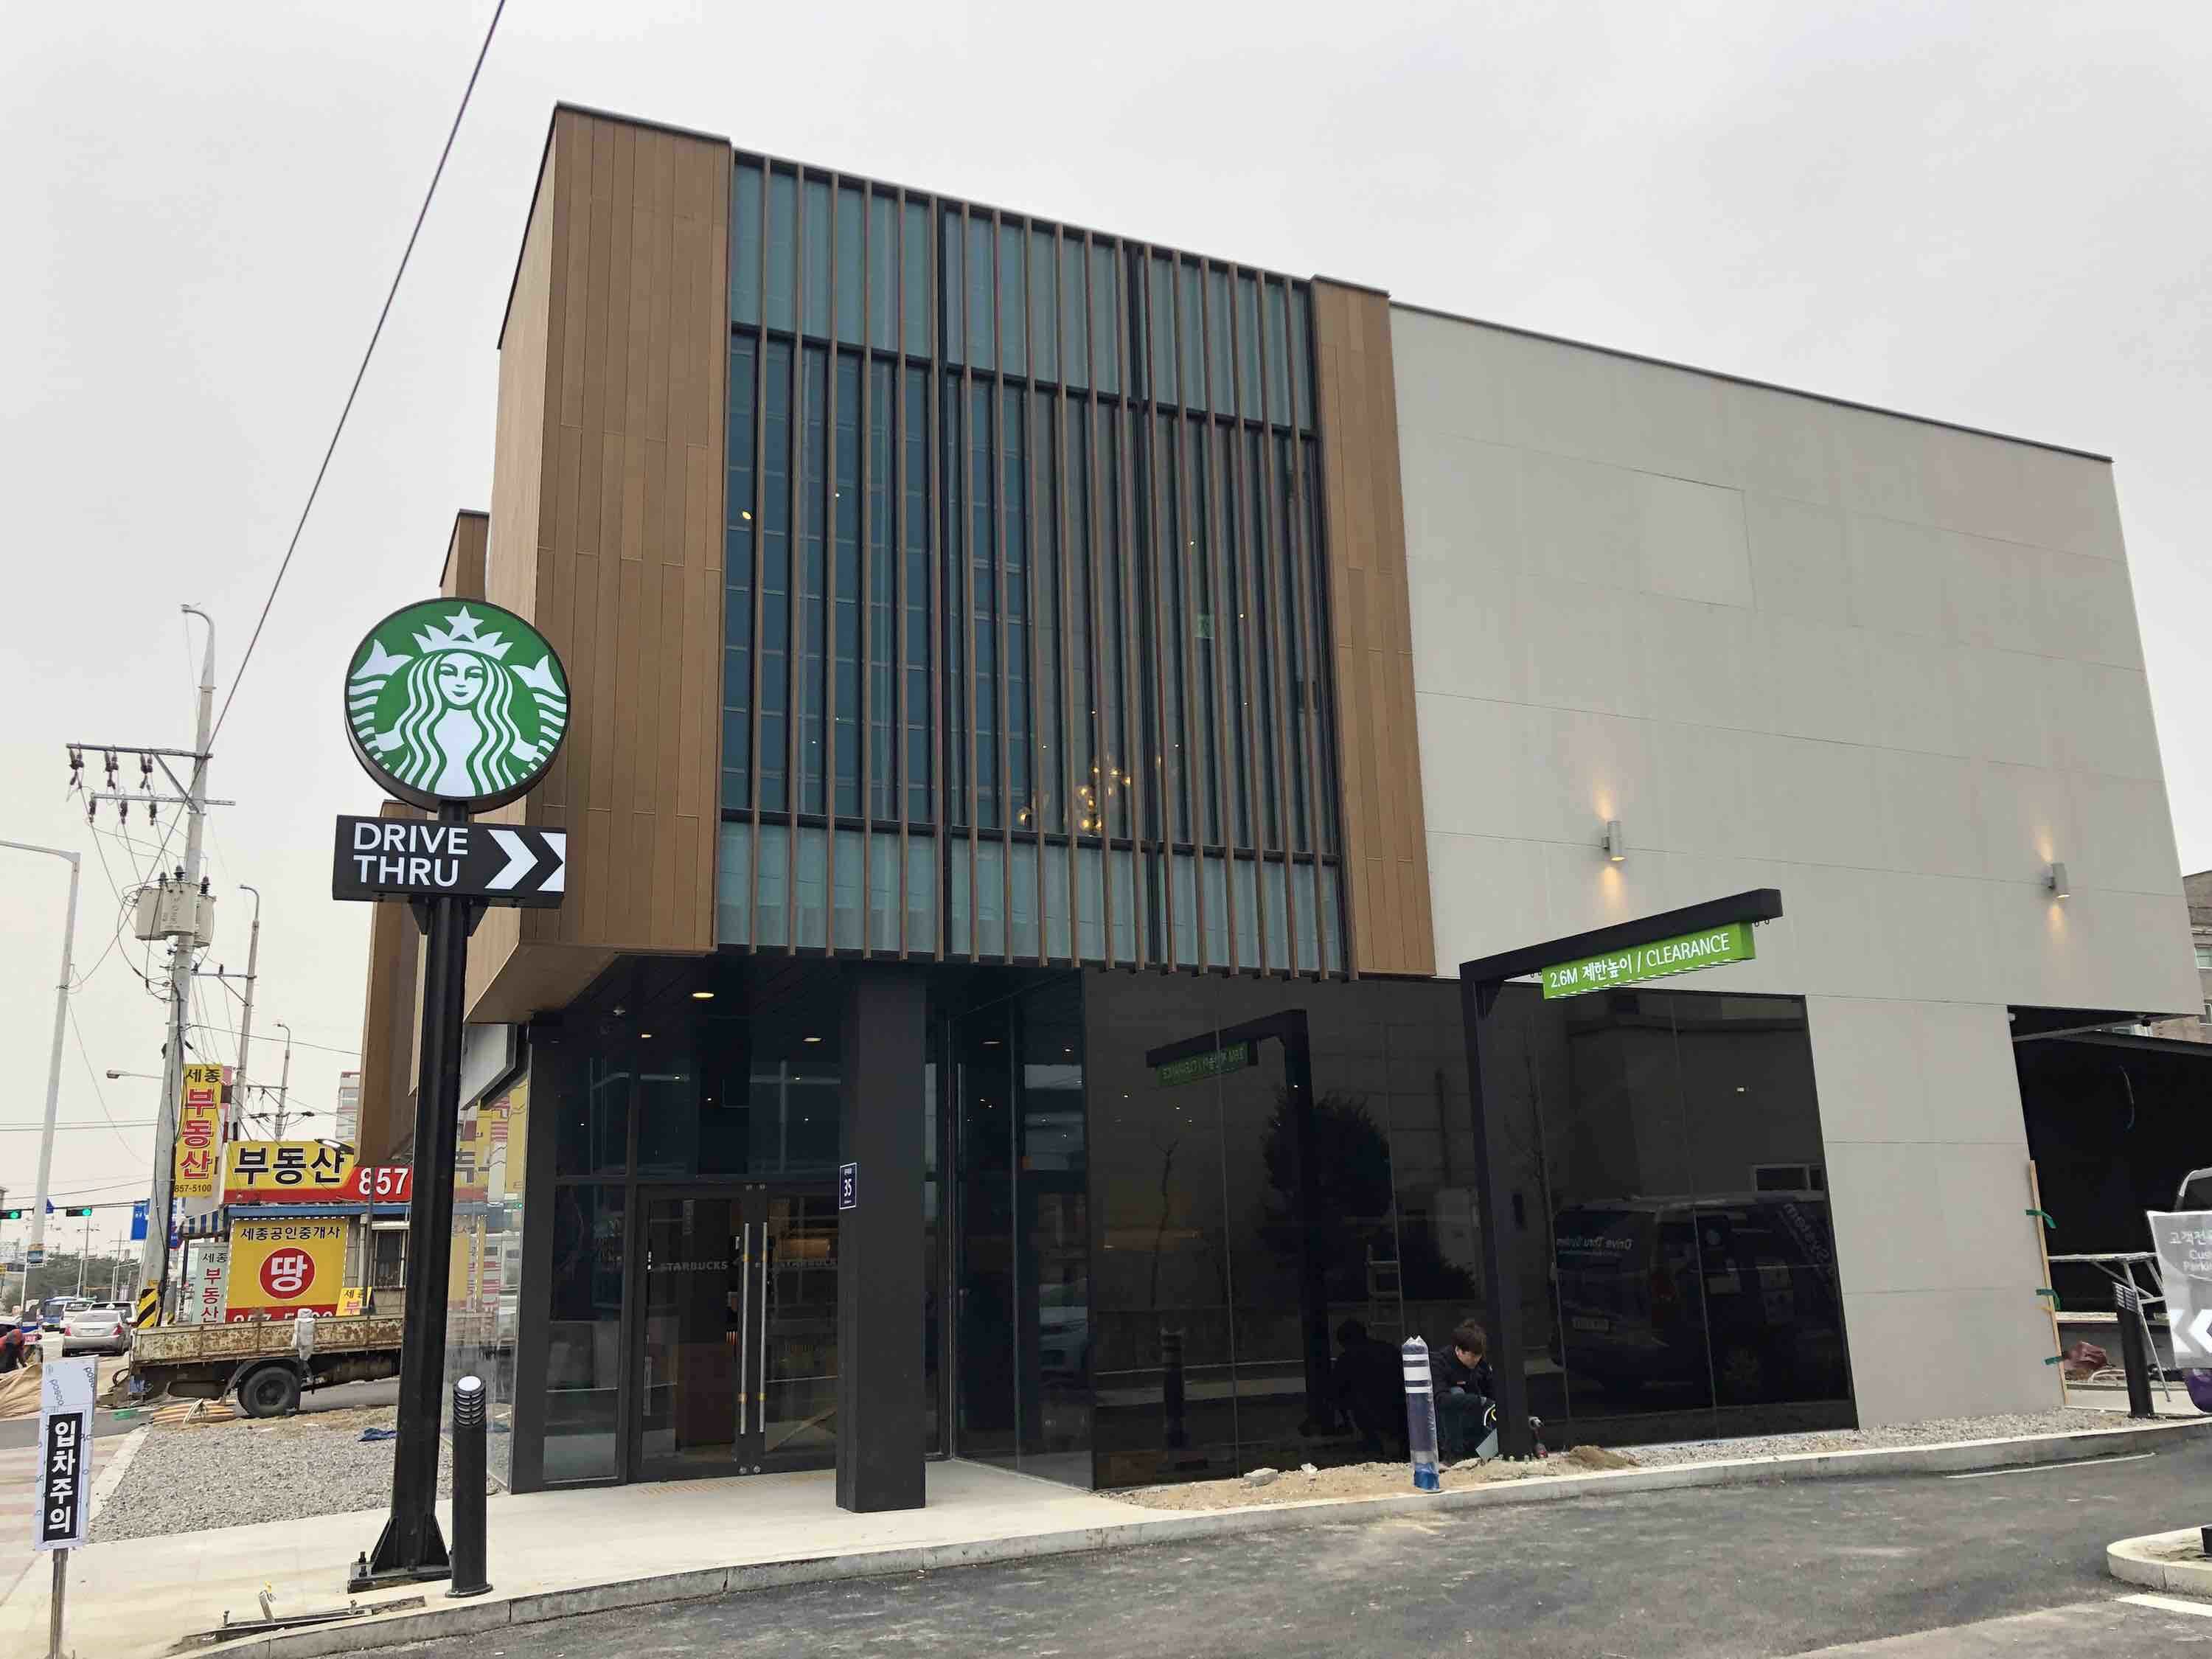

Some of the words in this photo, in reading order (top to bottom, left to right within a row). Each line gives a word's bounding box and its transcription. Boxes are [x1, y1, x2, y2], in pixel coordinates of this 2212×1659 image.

[353, 821, 469, 855] DRIVE
[352, 855, 459, 887] THRU
[1549, 967, 1579, 988] 2.6M
[1582, 953, 1632, 982] 제한높이
[1646, 932, 1731, 967] CLEARANCE
[186, 1068, 220, 1083] 세종
[180, 1088, 217, 1180] 부동산
[174, 1183, 212, 1193] 857-5100
[234, 1147, 345, 1186] 부동산
[358, 1167, 409, 1196] 857
[844, 1178, 852, 1197] 35
[240, 1225, 341, 1241] 세종공인중개사
[202, 1252, 228, 1263] 세종
[271, 1255, 308, 1292] 땅
[201, 1267, 222, 1323] 부동산
[48, 1420, 76, 1534] 입차주의
